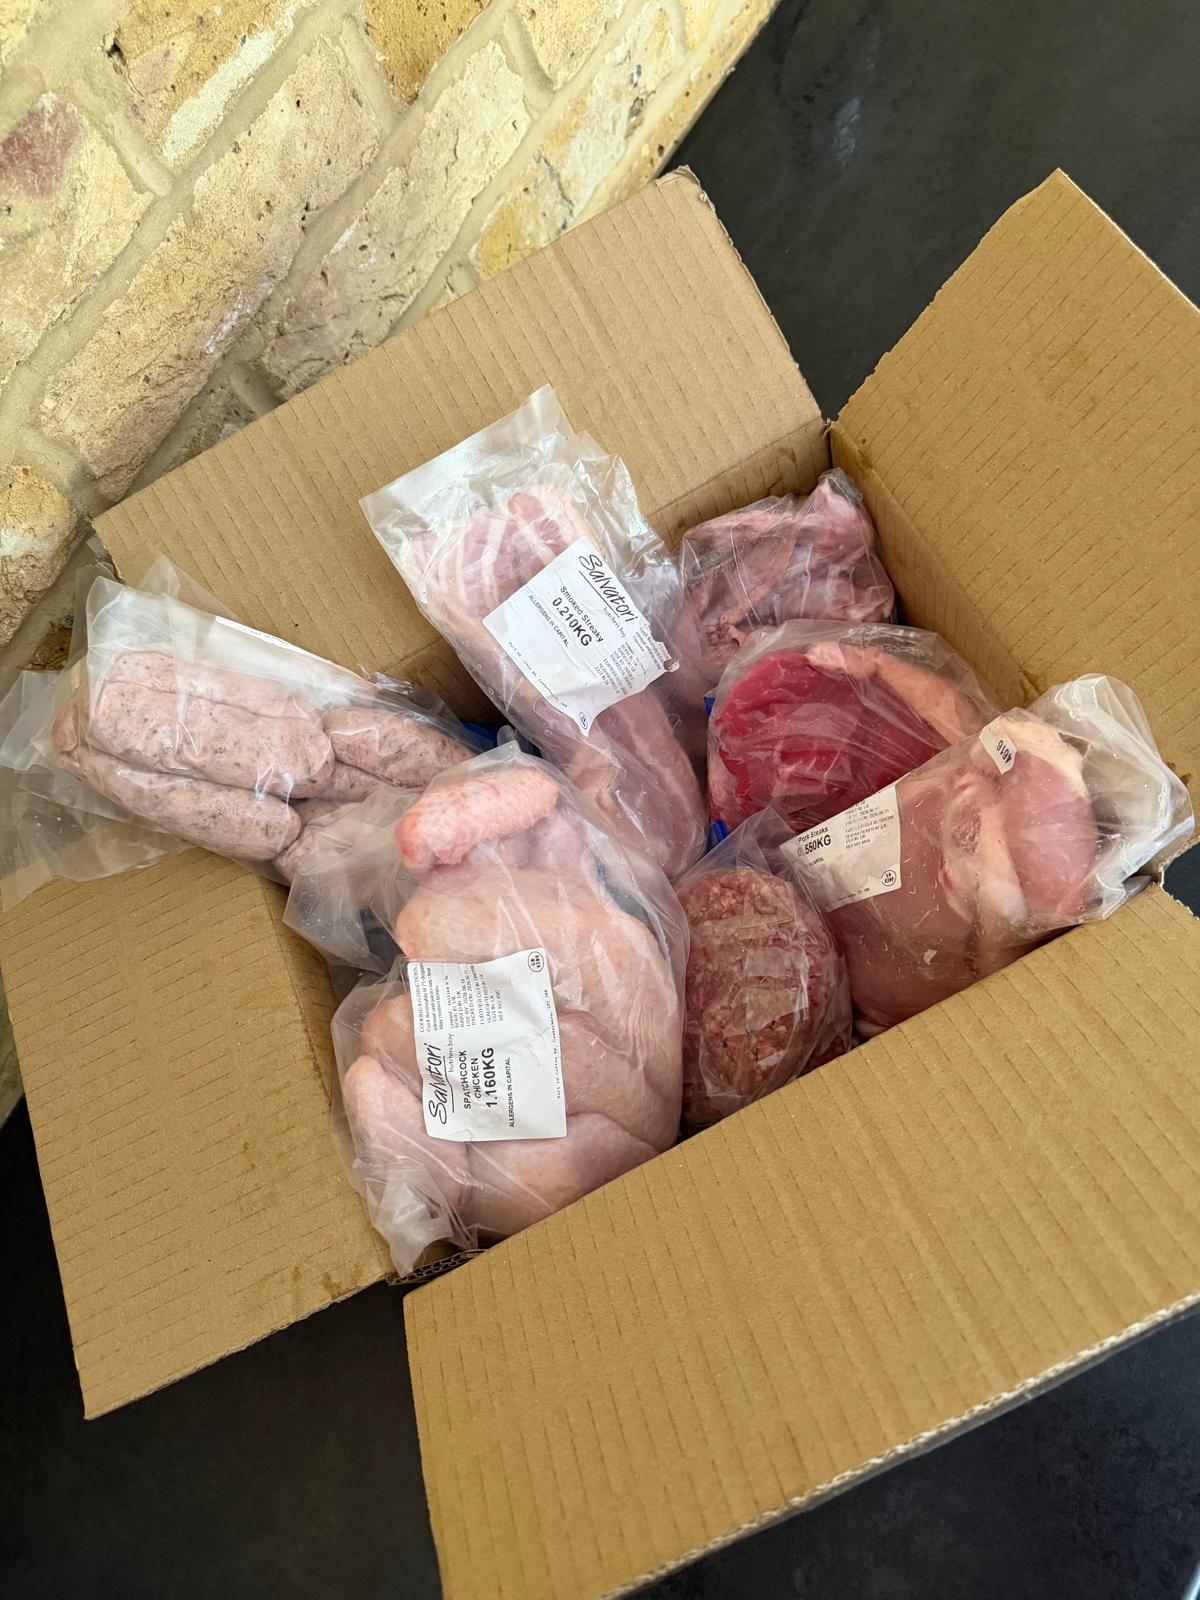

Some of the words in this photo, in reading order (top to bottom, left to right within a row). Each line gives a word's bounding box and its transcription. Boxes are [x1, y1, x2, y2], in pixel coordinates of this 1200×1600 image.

[529, 594, 551, 622] ALLERGENS
[579, 555, 638, 622] Salvatori
[552, 597, 592, 646] 0.210KG
[561, 586, 583, 615] Smoked
[581, 614, 604, 643] Streaky
[798, 833, 810, 842] Pork
[810, 827, 829, 838] Steaks
[458, 1050, 471, 1109] SPATCHCOCK
[471, 1057, 481, 1099] CHICKEN
[481, 1047, 498, 1108] 1.160KG
[507, 1084, 512, 1092] IN
[507, 1092, 515, 1127] ALLERGENS
